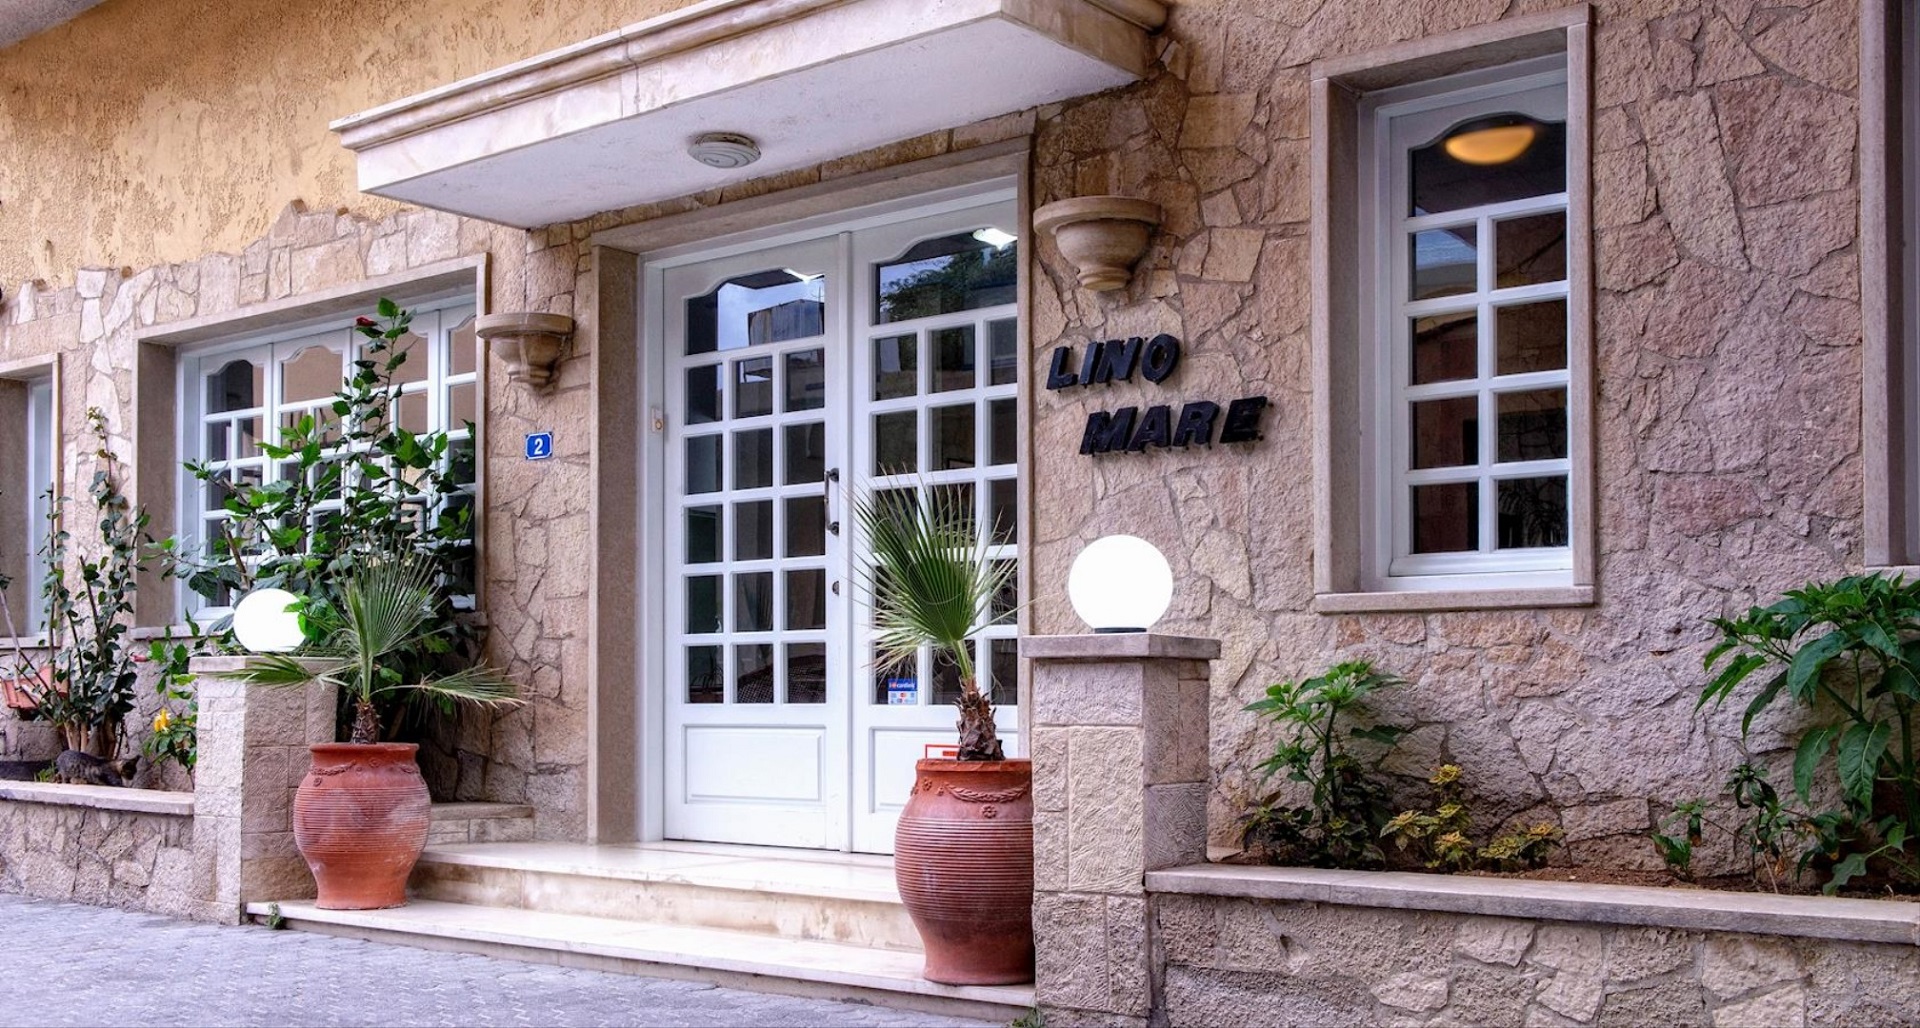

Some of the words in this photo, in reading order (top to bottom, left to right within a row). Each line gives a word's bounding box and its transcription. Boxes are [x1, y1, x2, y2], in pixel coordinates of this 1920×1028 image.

[1046, 333, 1181, 391] LINO
[534, 438, 543, 455] 2
[1079, 395, 1268, 455] MARE
